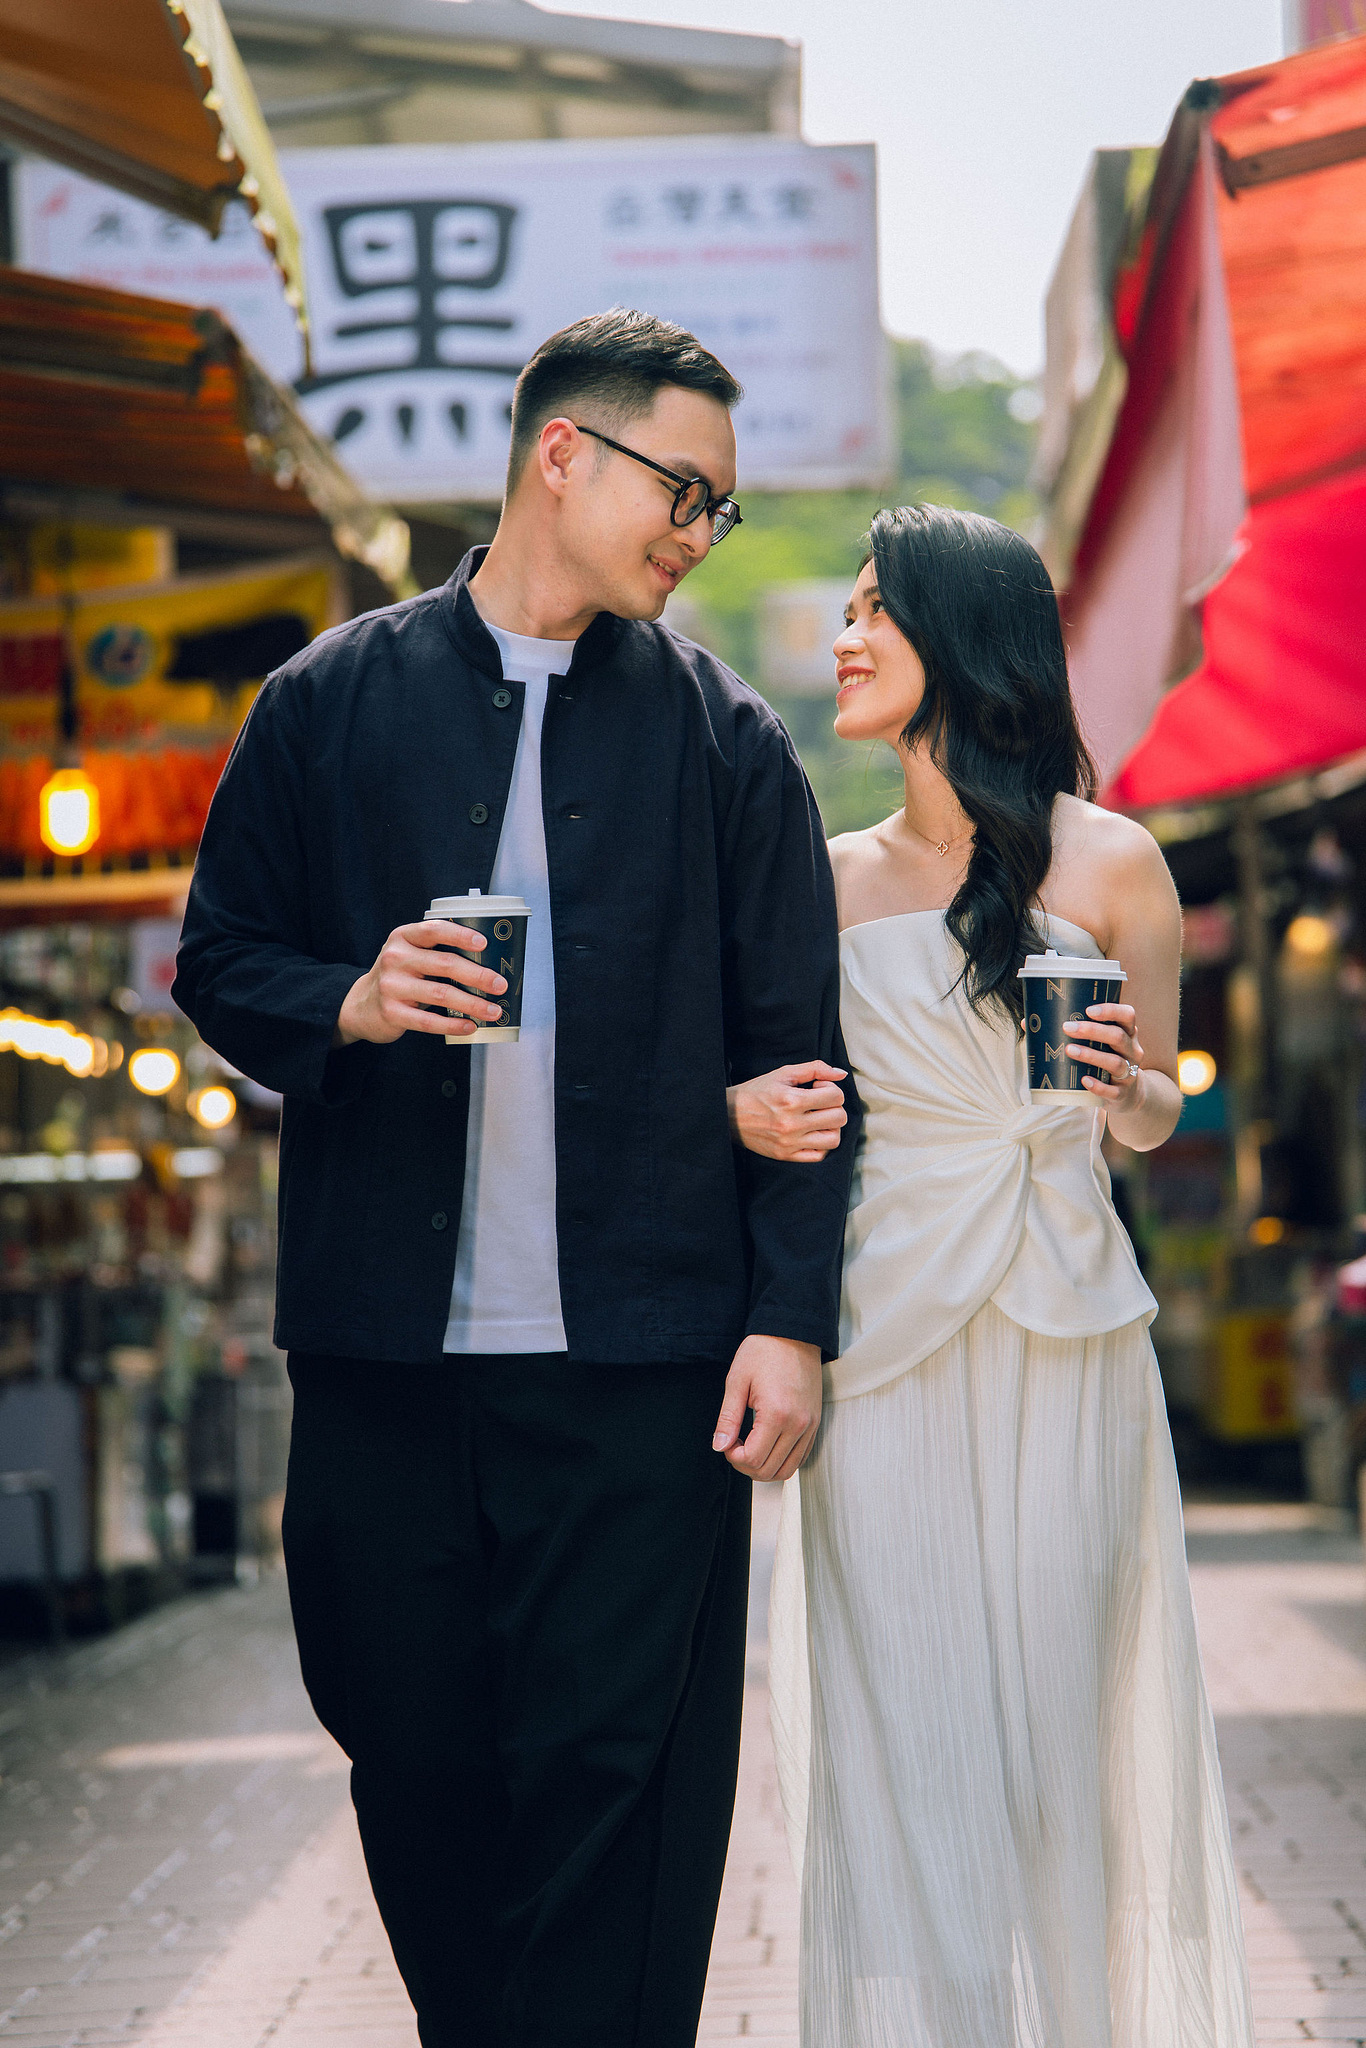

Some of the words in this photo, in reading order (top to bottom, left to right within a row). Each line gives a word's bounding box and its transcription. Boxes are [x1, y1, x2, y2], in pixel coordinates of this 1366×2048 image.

[293, 200, 522, 442] 黑
[1047, 979, 1066, 1000] N
[1045, 1042, 1065, 1062] M
